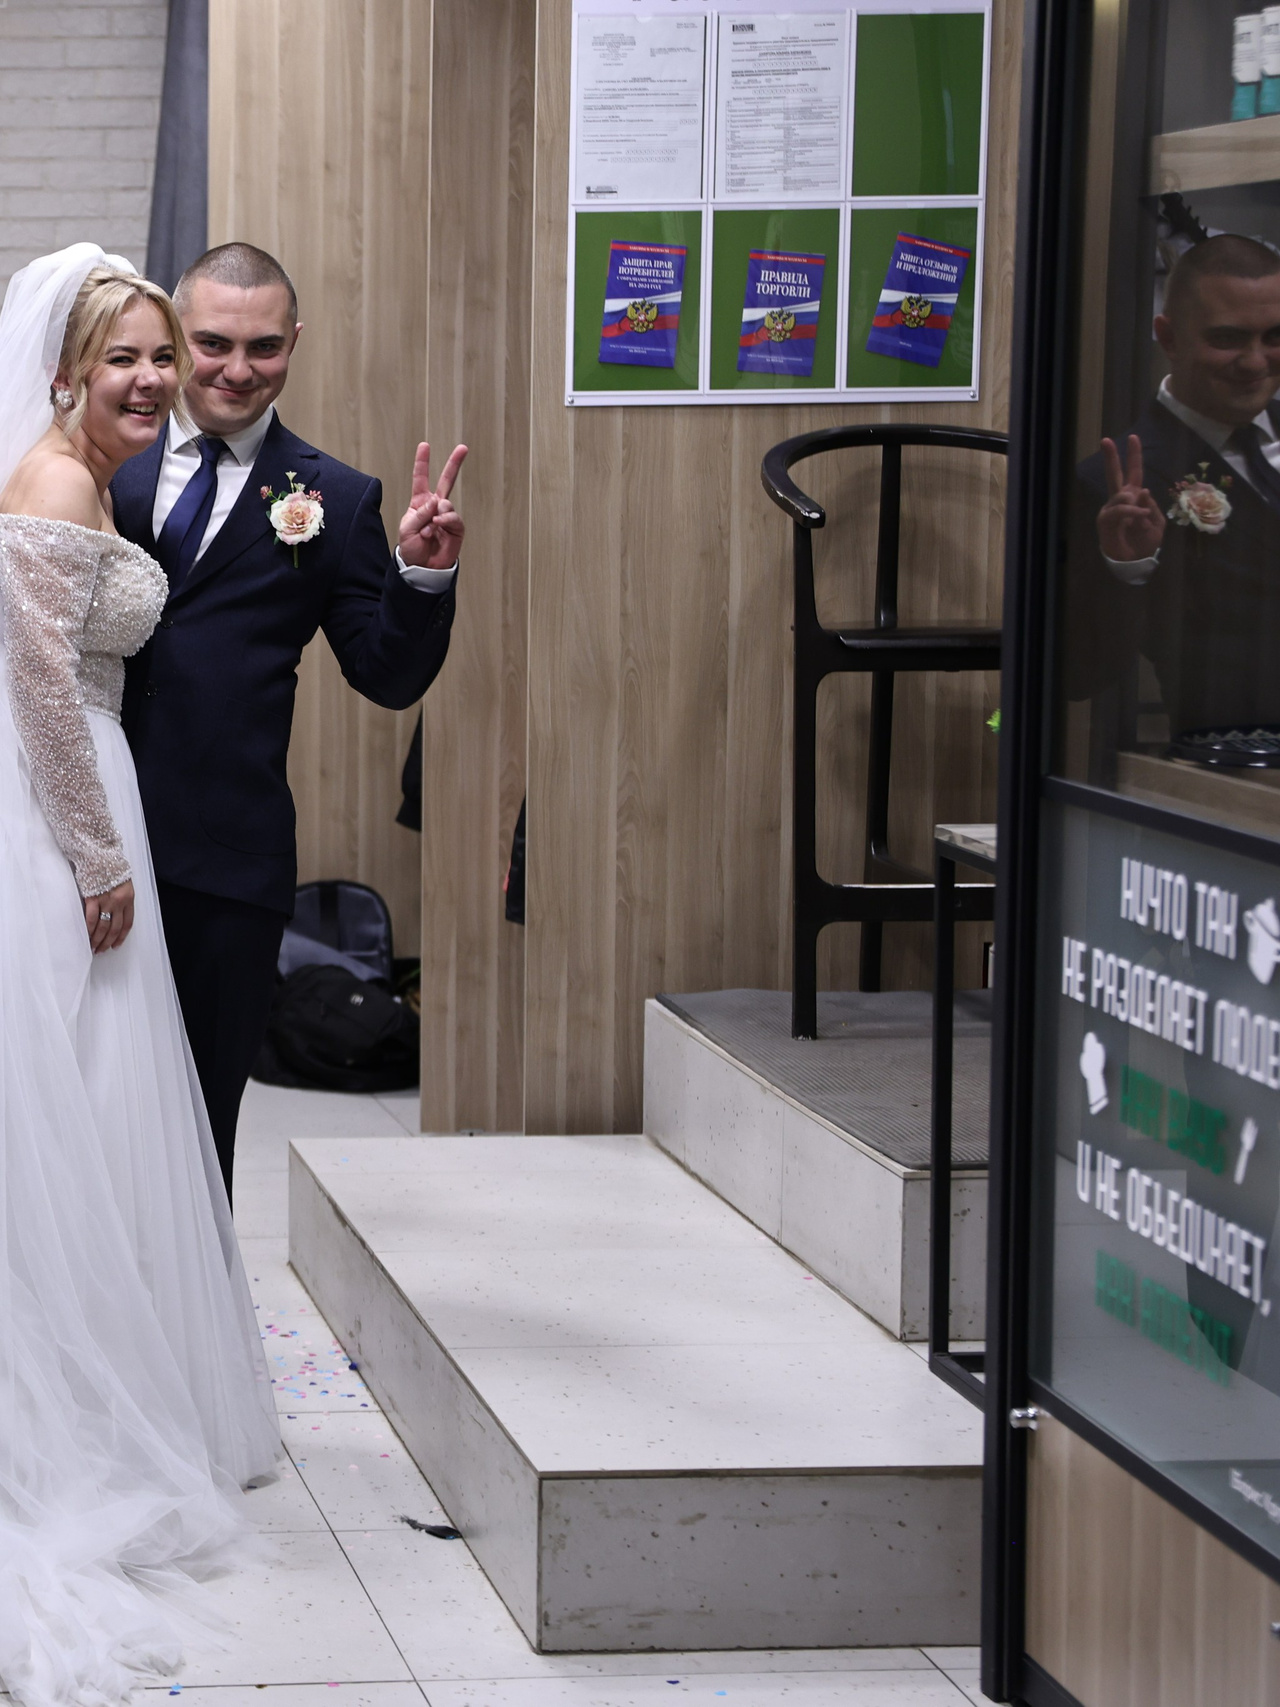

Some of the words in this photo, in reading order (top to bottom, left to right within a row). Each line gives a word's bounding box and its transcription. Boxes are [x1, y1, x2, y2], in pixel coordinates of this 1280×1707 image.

[618, 266, 675, 279] ПОТРЕБИТЕЛЕЙ
[622, 257, 653, 268] ЗАЩИТА
[653, 260, 673, 269] ПРАВ
[899, 252, 923, 266] КНИГА
[924, 258, 958, 274] ОТЗЫВОВ
[902, 262, 957, 283] ПРЕДЛОЖЕНИЙ
[760, 270, 809, 285] ПРАВИЛА
[756, 282, 811, 298] ТОРГОВЛИ
[1120, 857, 1188, 941] НИЧТО
[1194, 881, 1238, 960] ТАК
[1062, 936, 1087, 1003] НЕ
[1090, 948, 1208, 1055] РАЗДЕЛЯЕТ
[1076, 1140, 1091, 1203] И
[1096, 1150, 1121, 1221] НЕ
